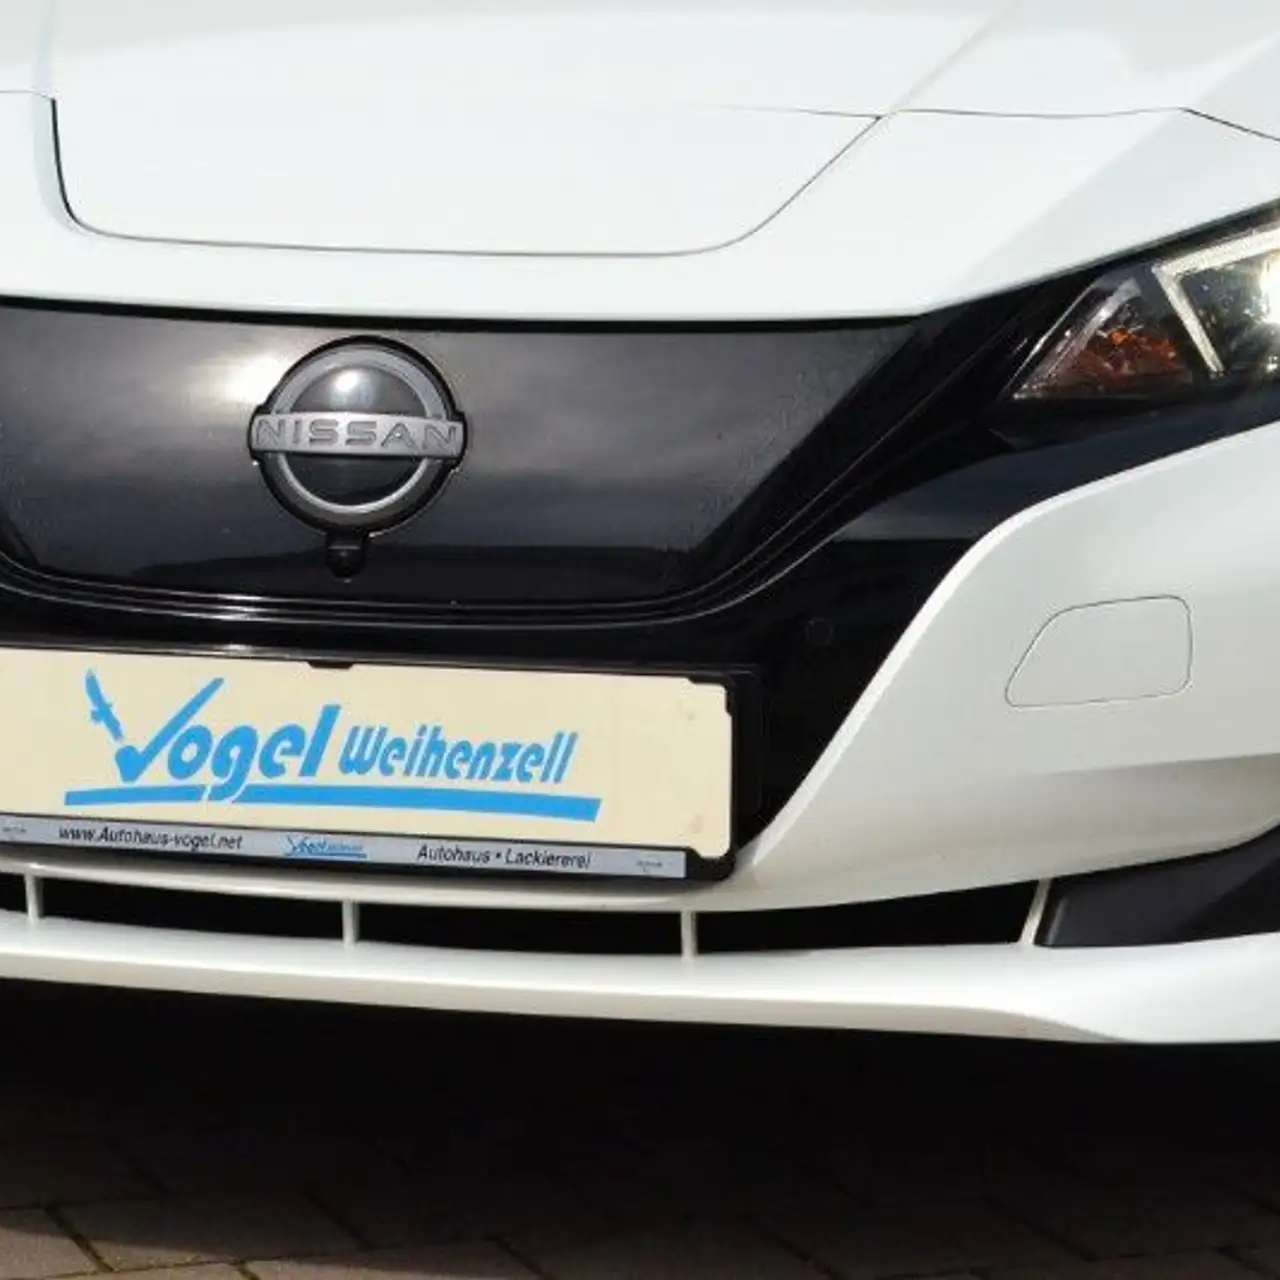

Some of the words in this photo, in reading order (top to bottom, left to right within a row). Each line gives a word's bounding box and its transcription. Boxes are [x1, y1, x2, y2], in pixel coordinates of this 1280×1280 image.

[255, 418, 458, 452] NISSAN
[85, 668, 342, 803] Vogel
[338, 724, 579, 784] Weihenzell
[58, 825, 244, 852] www.Autohaus-vogel.net
[417, 843, 491, 865] Autohaus
[504, 847, 594, 870] Lackiererei
